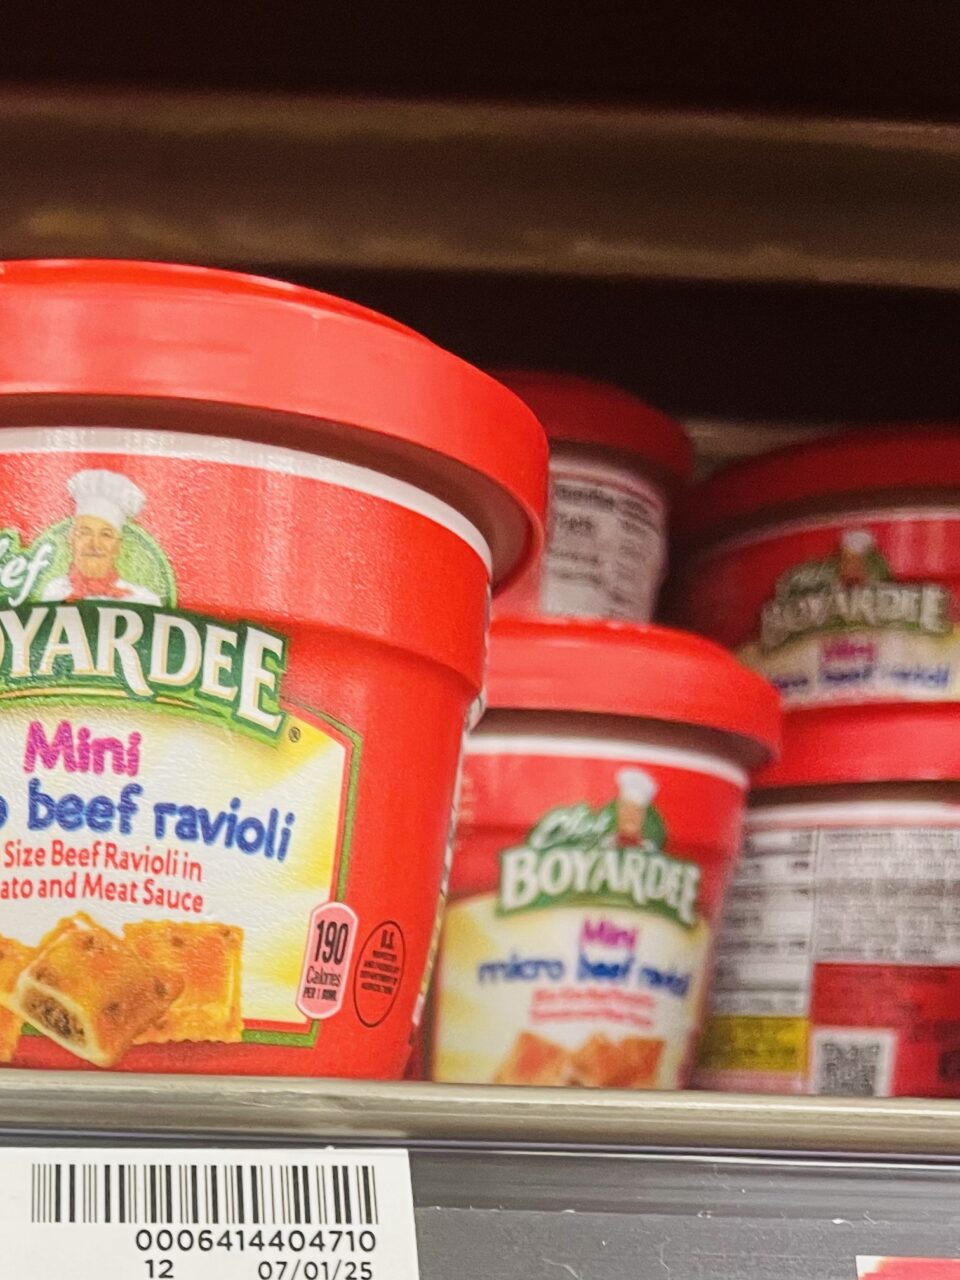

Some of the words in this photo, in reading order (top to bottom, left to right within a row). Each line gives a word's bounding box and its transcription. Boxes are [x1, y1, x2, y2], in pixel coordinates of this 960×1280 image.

[23, 720, 141, 776] Mini
[28, 778, 144, 835] beef
[153, 797, 295, 862] ravioli
[4, 839, 46, 868] Size
[50, 839, 101, 869] Beef
[104, 842, 180, 875] Ravioli
[183, 853, 202, 881] in
[38, 872, 77, 899] and
[82, 873, 138, 905] Meat
[143, 878, 204, 914] Sauce
[315, 920, 349, 965] 190
[306, 966, 341, 987] Calories
[137, 1229, 376, 1253] 0006414404710
[146, 1259, 174, 1279] 12
